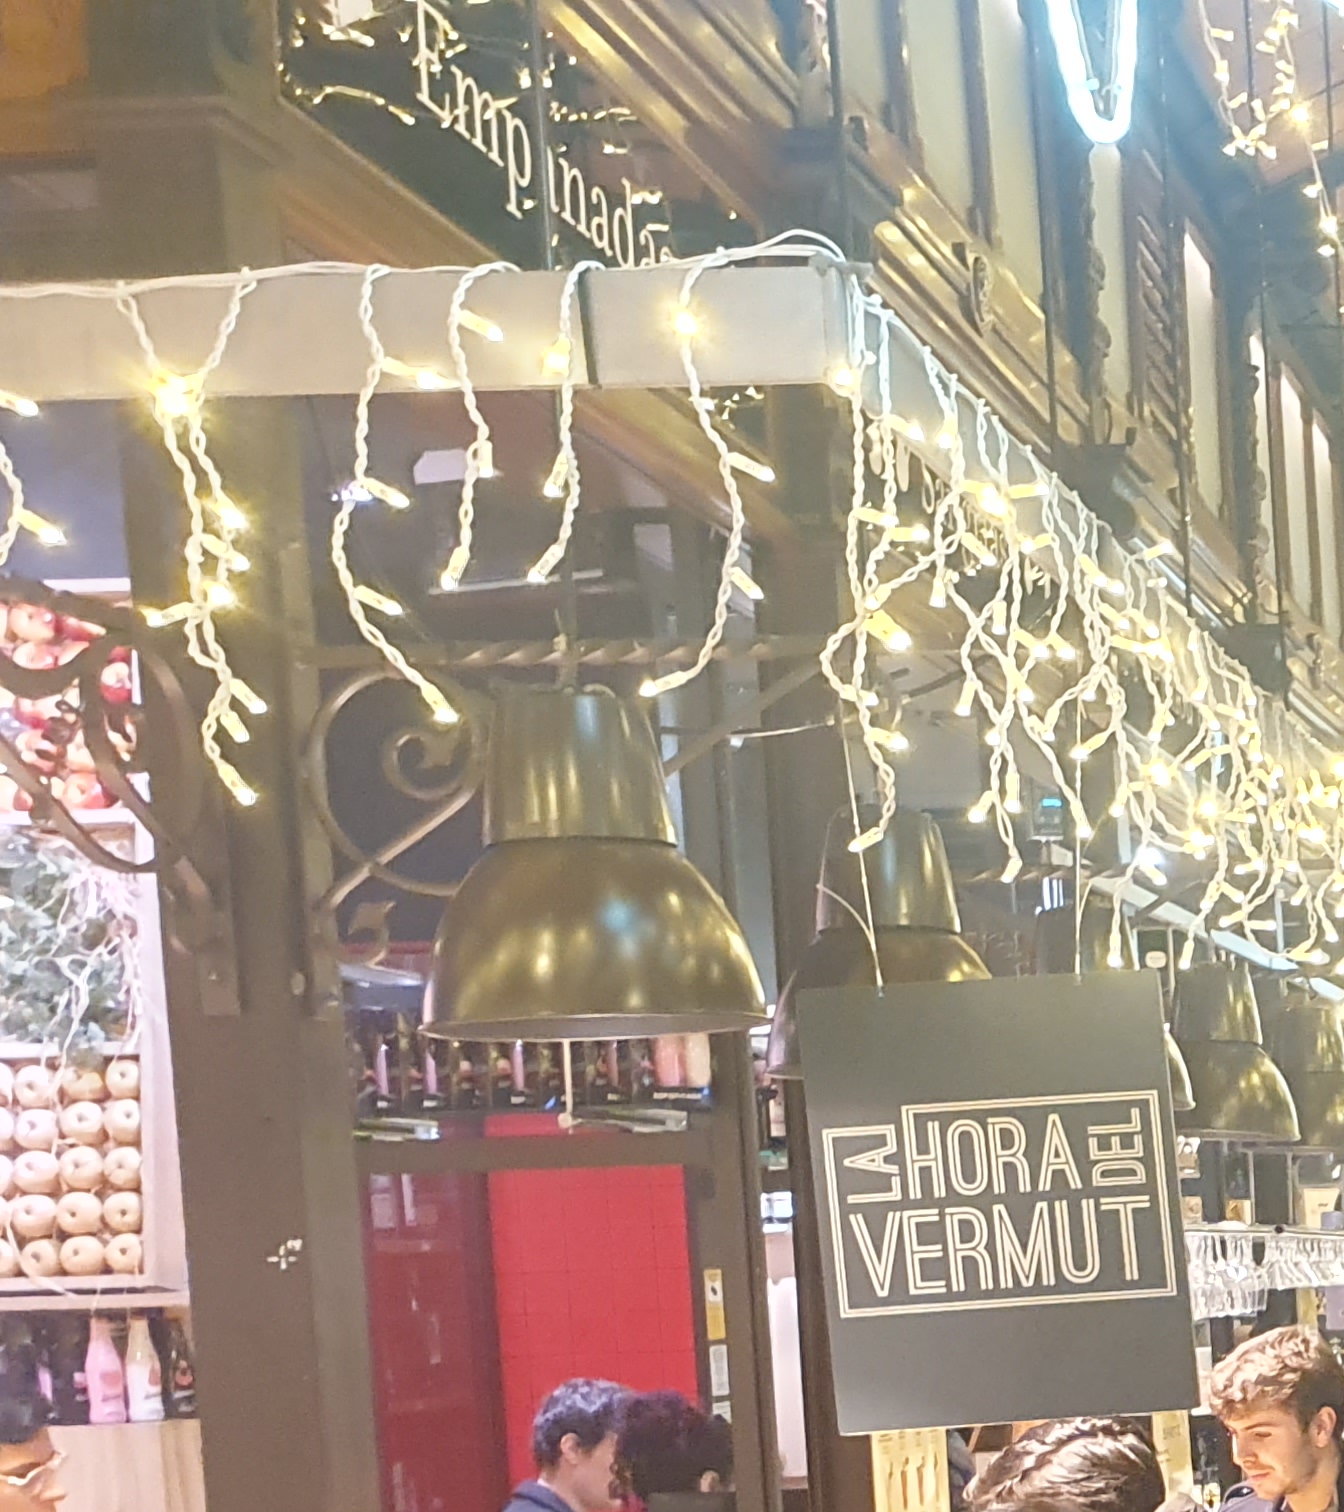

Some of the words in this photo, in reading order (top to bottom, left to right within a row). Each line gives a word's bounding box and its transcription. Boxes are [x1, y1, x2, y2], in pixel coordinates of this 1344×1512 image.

[842, 1143, 902, 1204] LA
[904, 1112, 1083, 1199] HORA
[1087, 1107, 1147, 1187] DEL
[849, 1195, 1151, 1298] VERMUT
